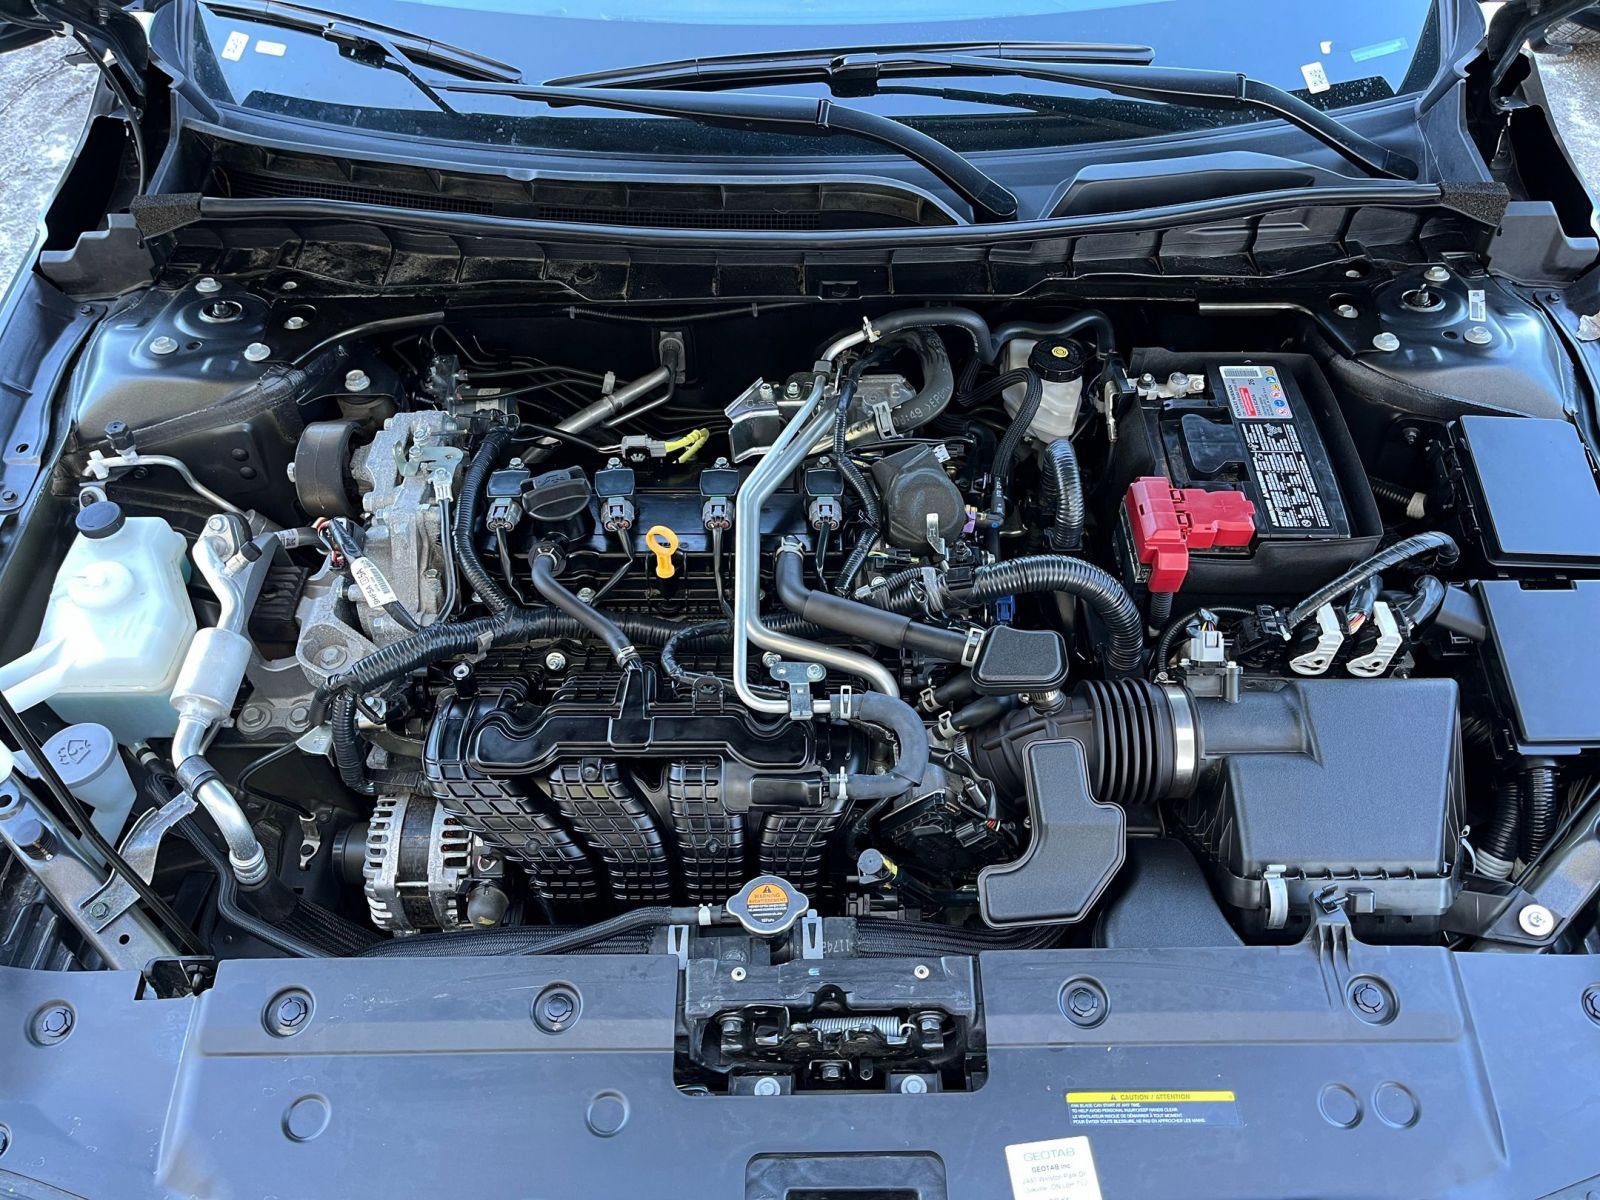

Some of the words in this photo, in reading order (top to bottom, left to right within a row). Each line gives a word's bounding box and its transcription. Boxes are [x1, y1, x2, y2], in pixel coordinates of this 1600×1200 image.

[1120, 1093, 1149, 1101] CAUTION
[1023, 1147, 1076, 1162] GEOTAB
[1031, 1163, 1060, 1174] GEOTAB
